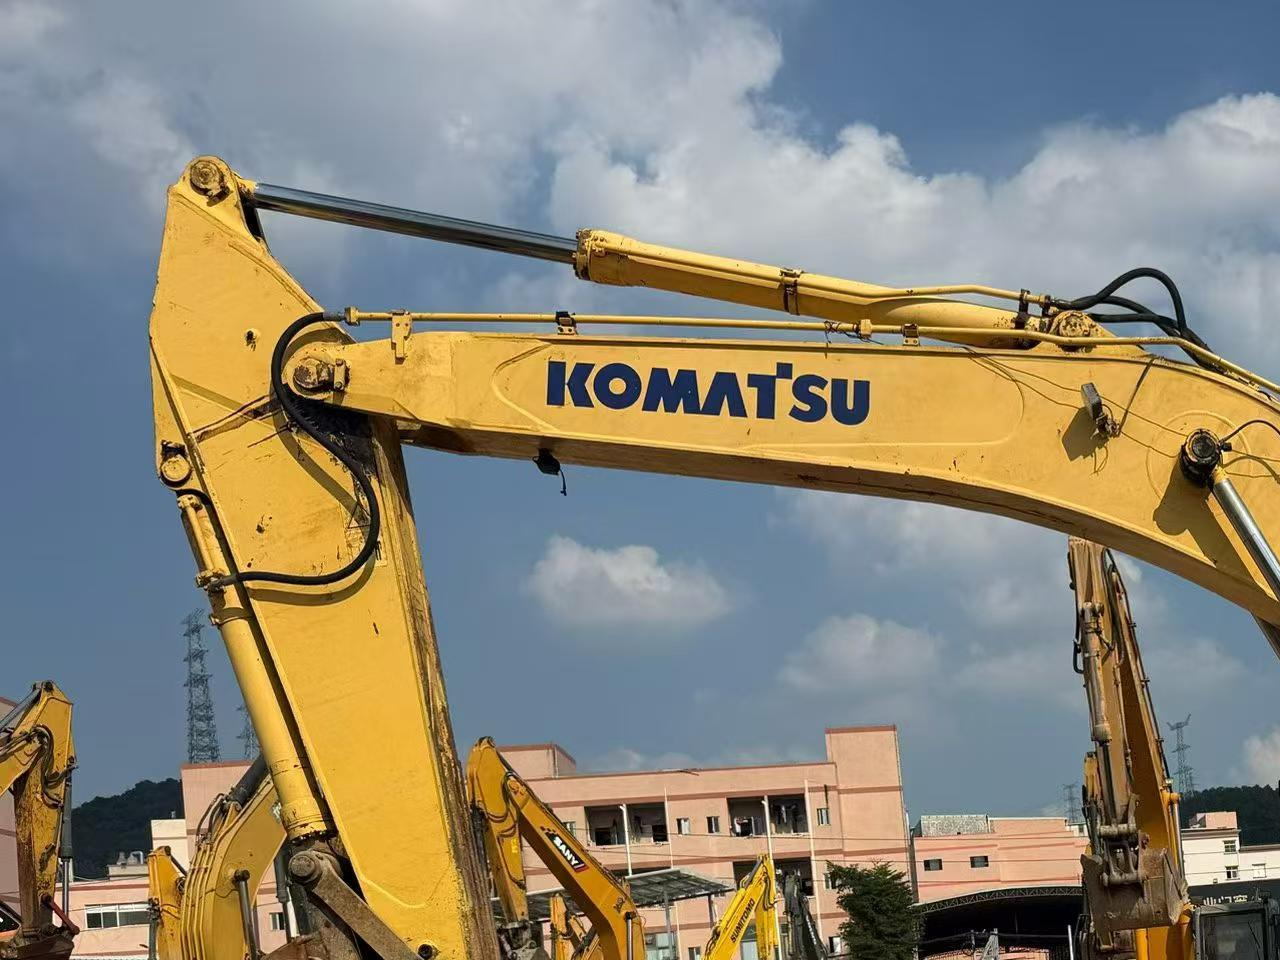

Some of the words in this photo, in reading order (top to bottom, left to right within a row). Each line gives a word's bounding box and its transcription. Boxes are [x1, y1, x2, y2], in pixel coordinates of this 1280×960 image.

[547, 360, 870, 426] KOMATSU
[553, 836, 579, 866] SANY
[730, 898, 756, 943] SUMITOMO
